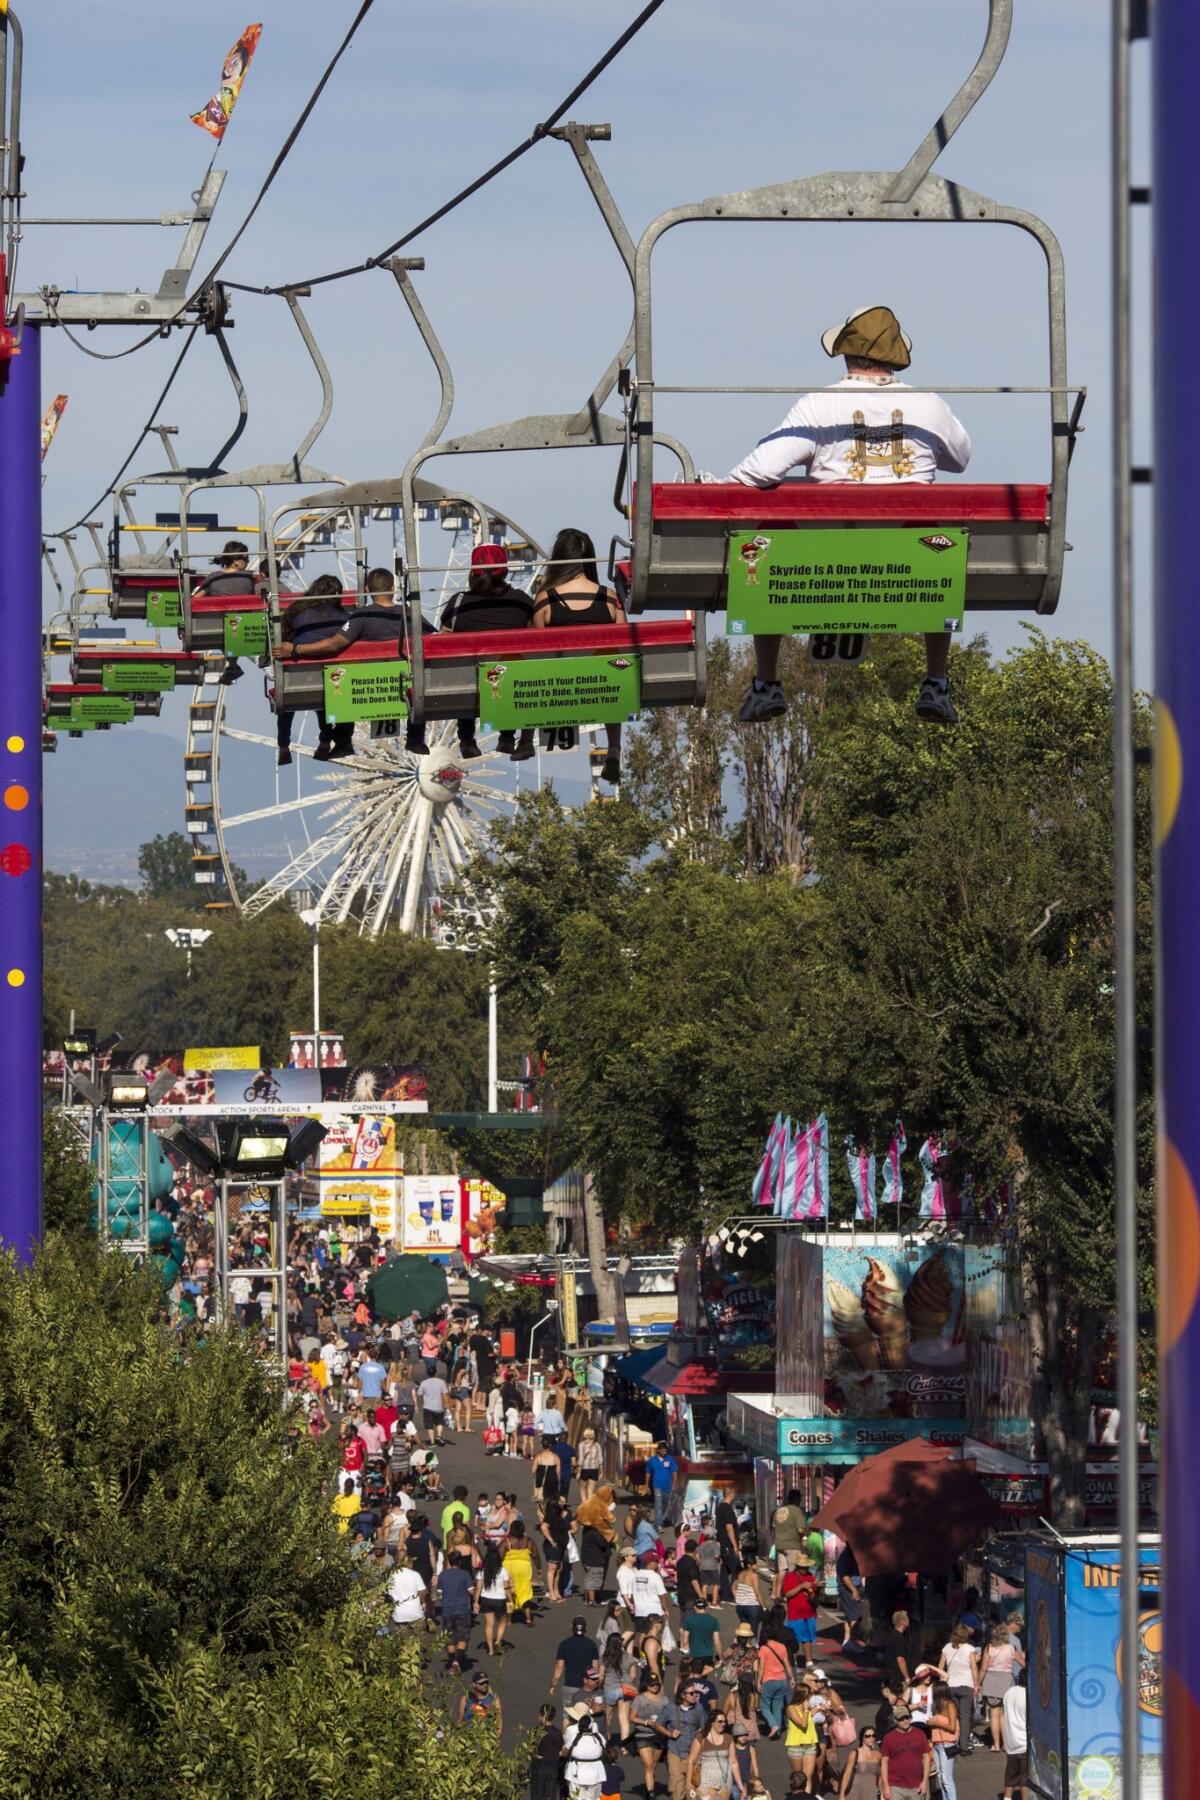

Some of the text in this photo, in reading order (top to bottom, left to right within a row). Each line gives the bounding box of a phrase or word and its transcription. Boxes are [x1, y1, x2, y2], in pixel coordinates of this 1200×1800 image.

[769, 563, 912, 577] Skyride Is A One Way Ride
[768, 577, 953, 590] Please Follow The Instructions Of
[768, 592, 945, 604] The Attendant At The End Of Ride
[792, 621, 897, 631] www.RCSFUN.com
[811, 633, 865, 660] 80
[351, 678, 375, 686] Please
[376, 676, 389, 684] Exit
[513, 674, 608, 688] Parents If Your Child Is
[351, 687, 365, 695] And
[366, 686, 375, 694] To
[375, 686, 389, 694] The
[513, 689, 539, 699] Afraid
[540, 688, 551, 698] To
[574, 685, 621, 696] Remember
[351, 695, 401, 705] Ride Does Not
[513, 695, 619, 710] There Is Always Next Year
[543, 726, 575, 751] 79
[249, 1106, 275, 1114] SPORTS
[352, 1104, 388, 1112] CARNIVAL
[789, 1430, 833, 1444] Cones
[856, 1430, 906, 1444] Shakes
[992, 1490, 1035, 1502] PIZZA
